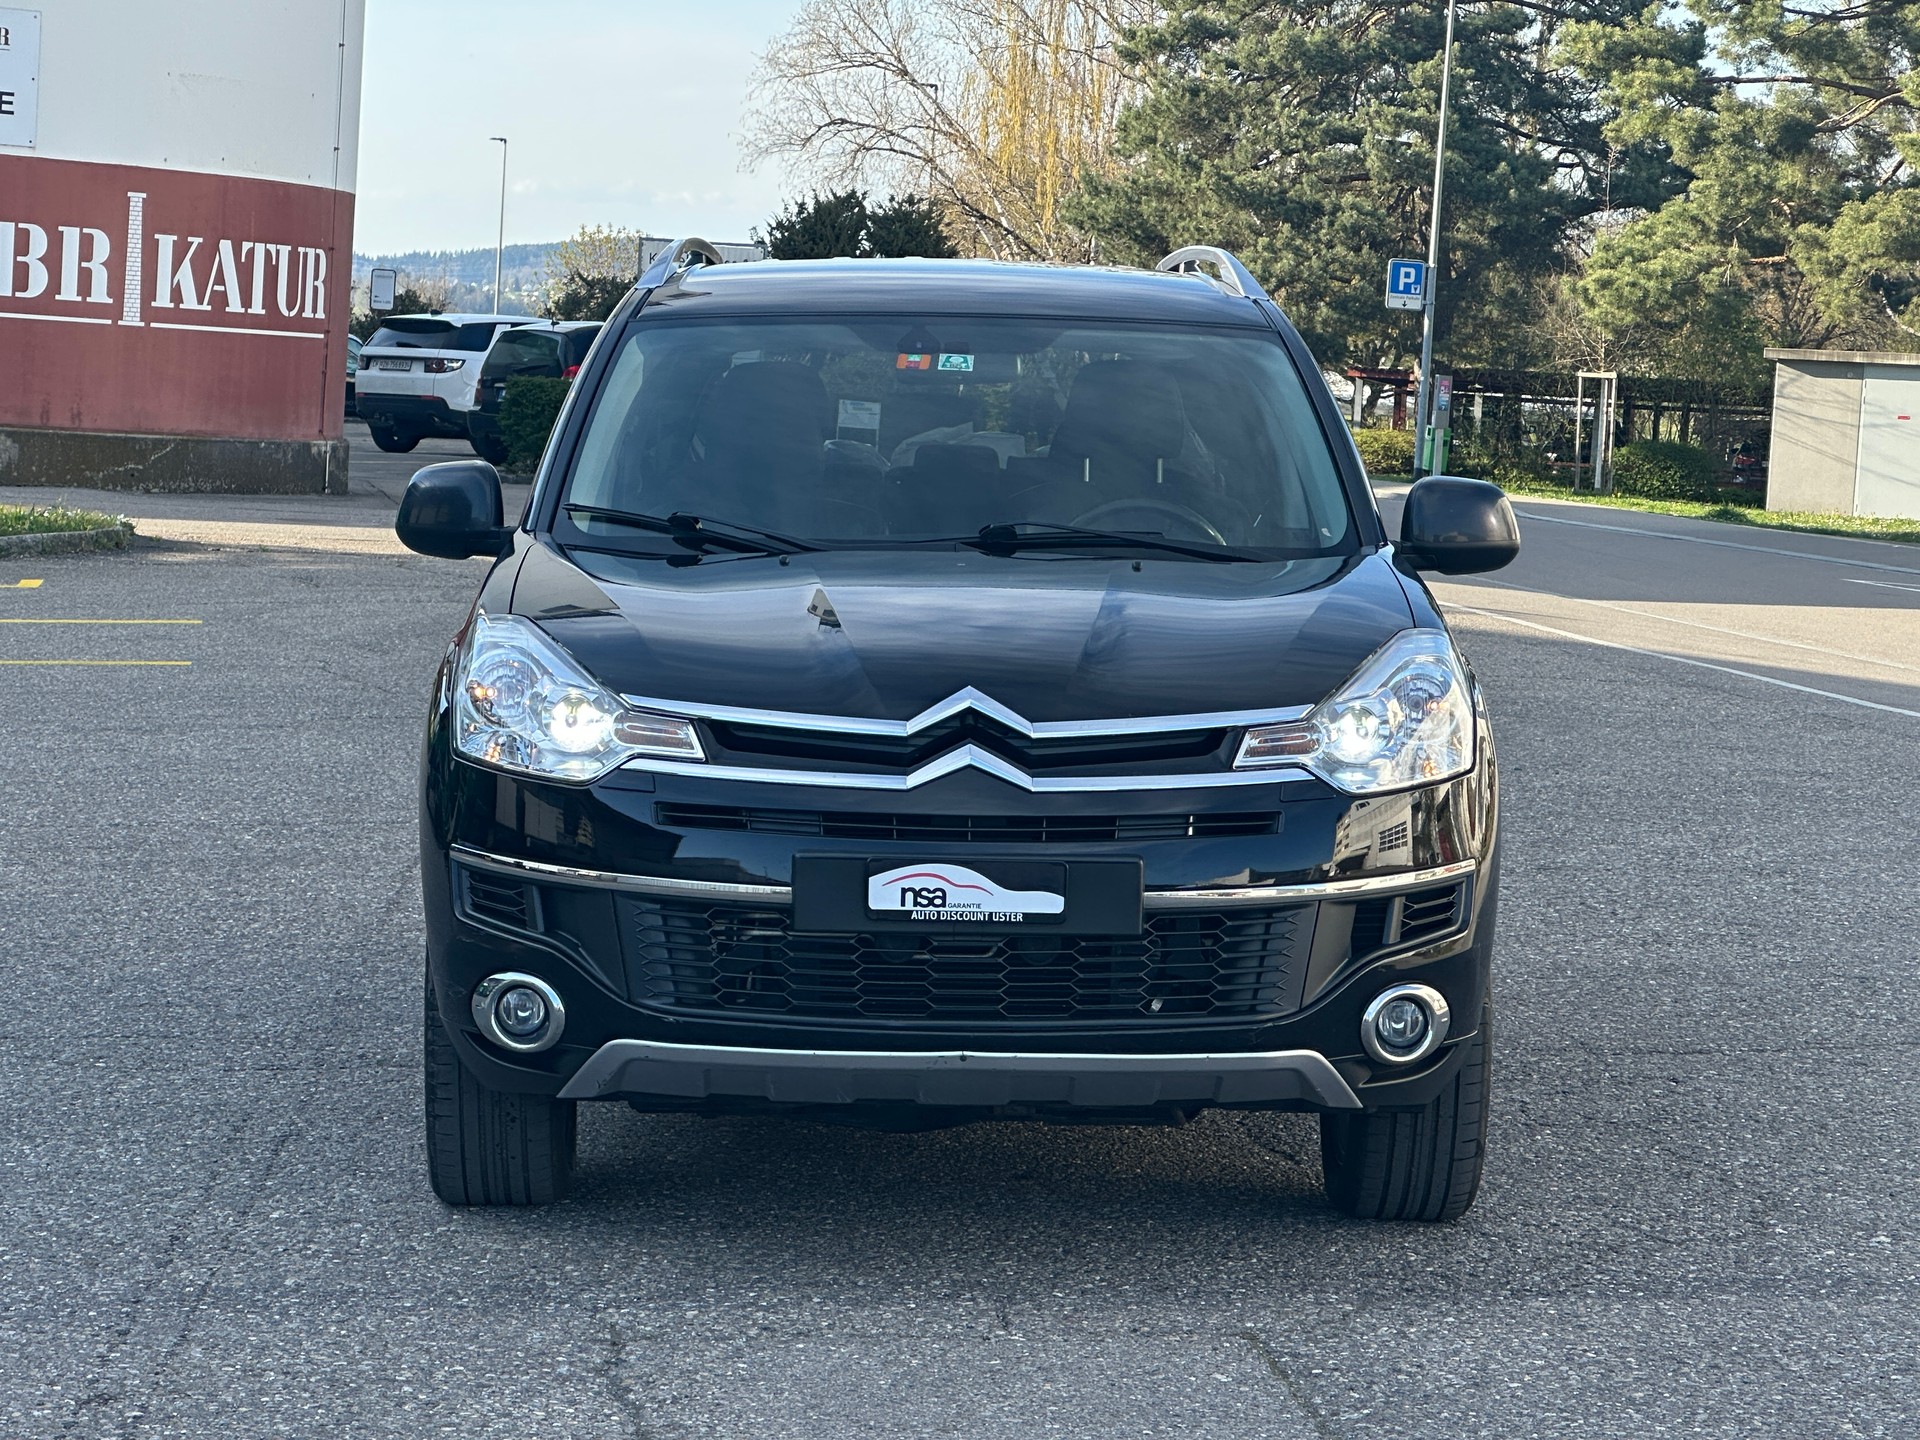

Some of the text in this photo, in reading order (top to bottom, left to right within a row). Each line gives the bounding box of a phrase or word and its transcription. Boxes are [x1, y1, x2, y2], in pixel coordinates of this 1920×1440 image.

[1399, 267, 1415, 290] P
[901, 887, 947, 908] nsa
[911, 910, 1023, 922] AUTO DISCOUNT USTER
